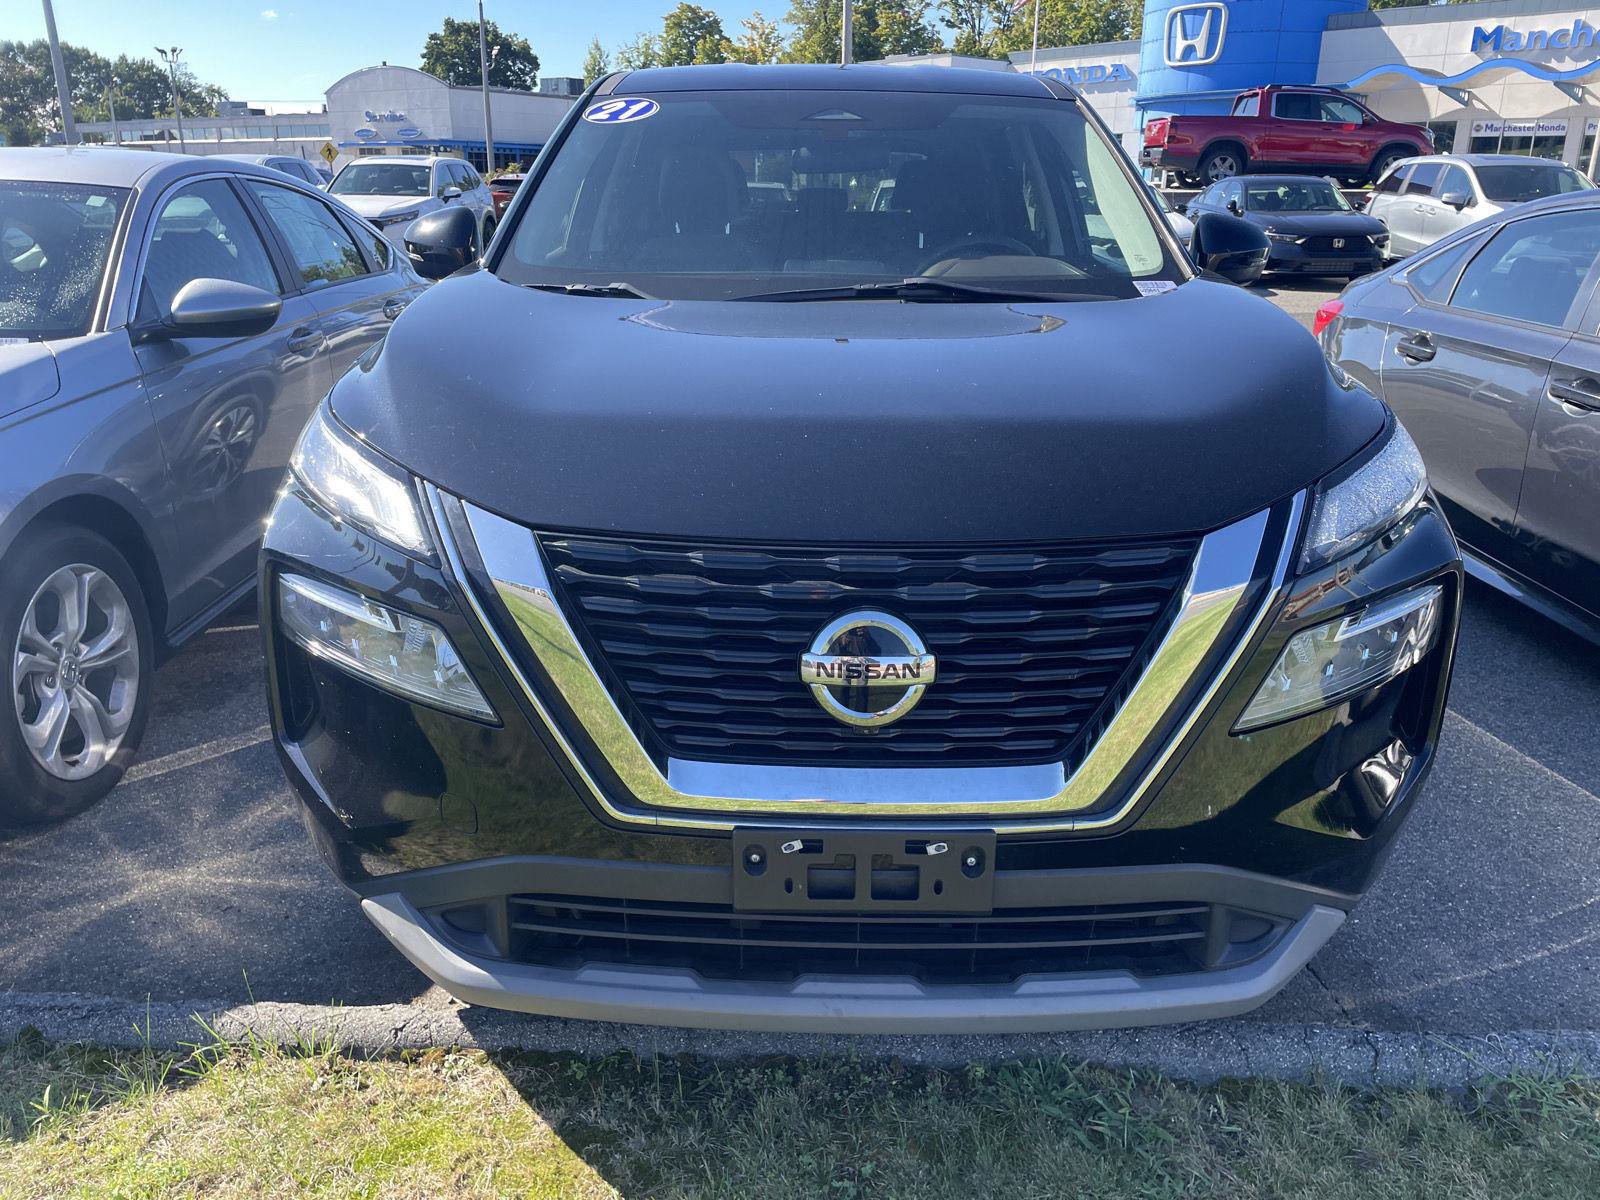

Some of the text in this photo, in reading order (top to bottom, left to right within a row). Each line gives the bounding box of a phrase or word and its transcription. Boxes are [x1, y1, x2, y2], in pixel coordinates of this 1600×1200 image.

[1471, 19, 1600, 52] Manch
[587, 101, 650, 120] 21
[1484, 123, 1566, 132] Manchester Honda
[816, 662, 921, 679] NISSAN
